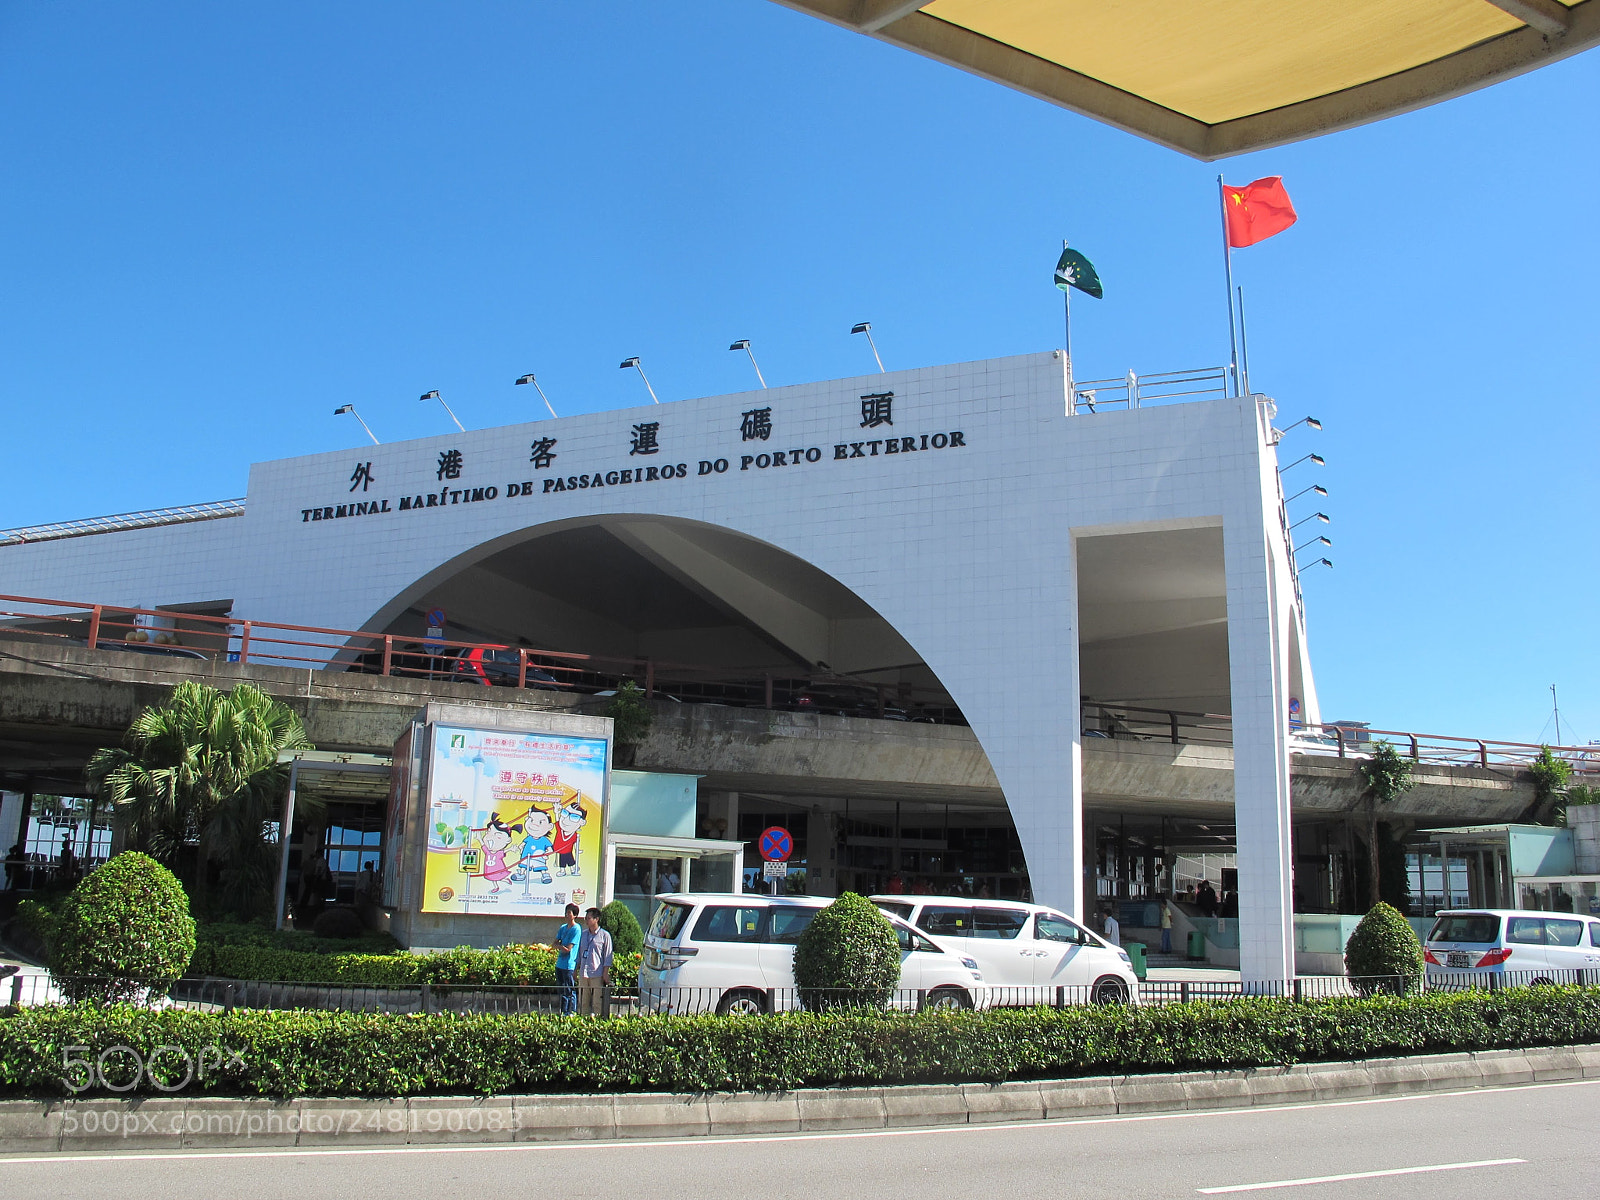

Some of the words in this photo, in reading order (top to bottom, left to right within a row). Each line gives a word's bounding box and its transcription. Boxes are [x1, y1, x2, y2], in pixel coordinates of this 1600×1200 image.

[301, 500, 391, 522] TERMINAL
[399, 487, 498, 511] MARÍTIMO
[507, 481, 533, 497] DE
[542, 463, 688, 494] PASSAGEIROS
[698, 458, 729, 476] DO
[740, 447, 822, 470] PORTO
[833, 431, 966, 461] EXTERIOR
[350, 391, 894, 492] 外港客運碼頭
[500, 771, 559, 786] 遵守秩序
